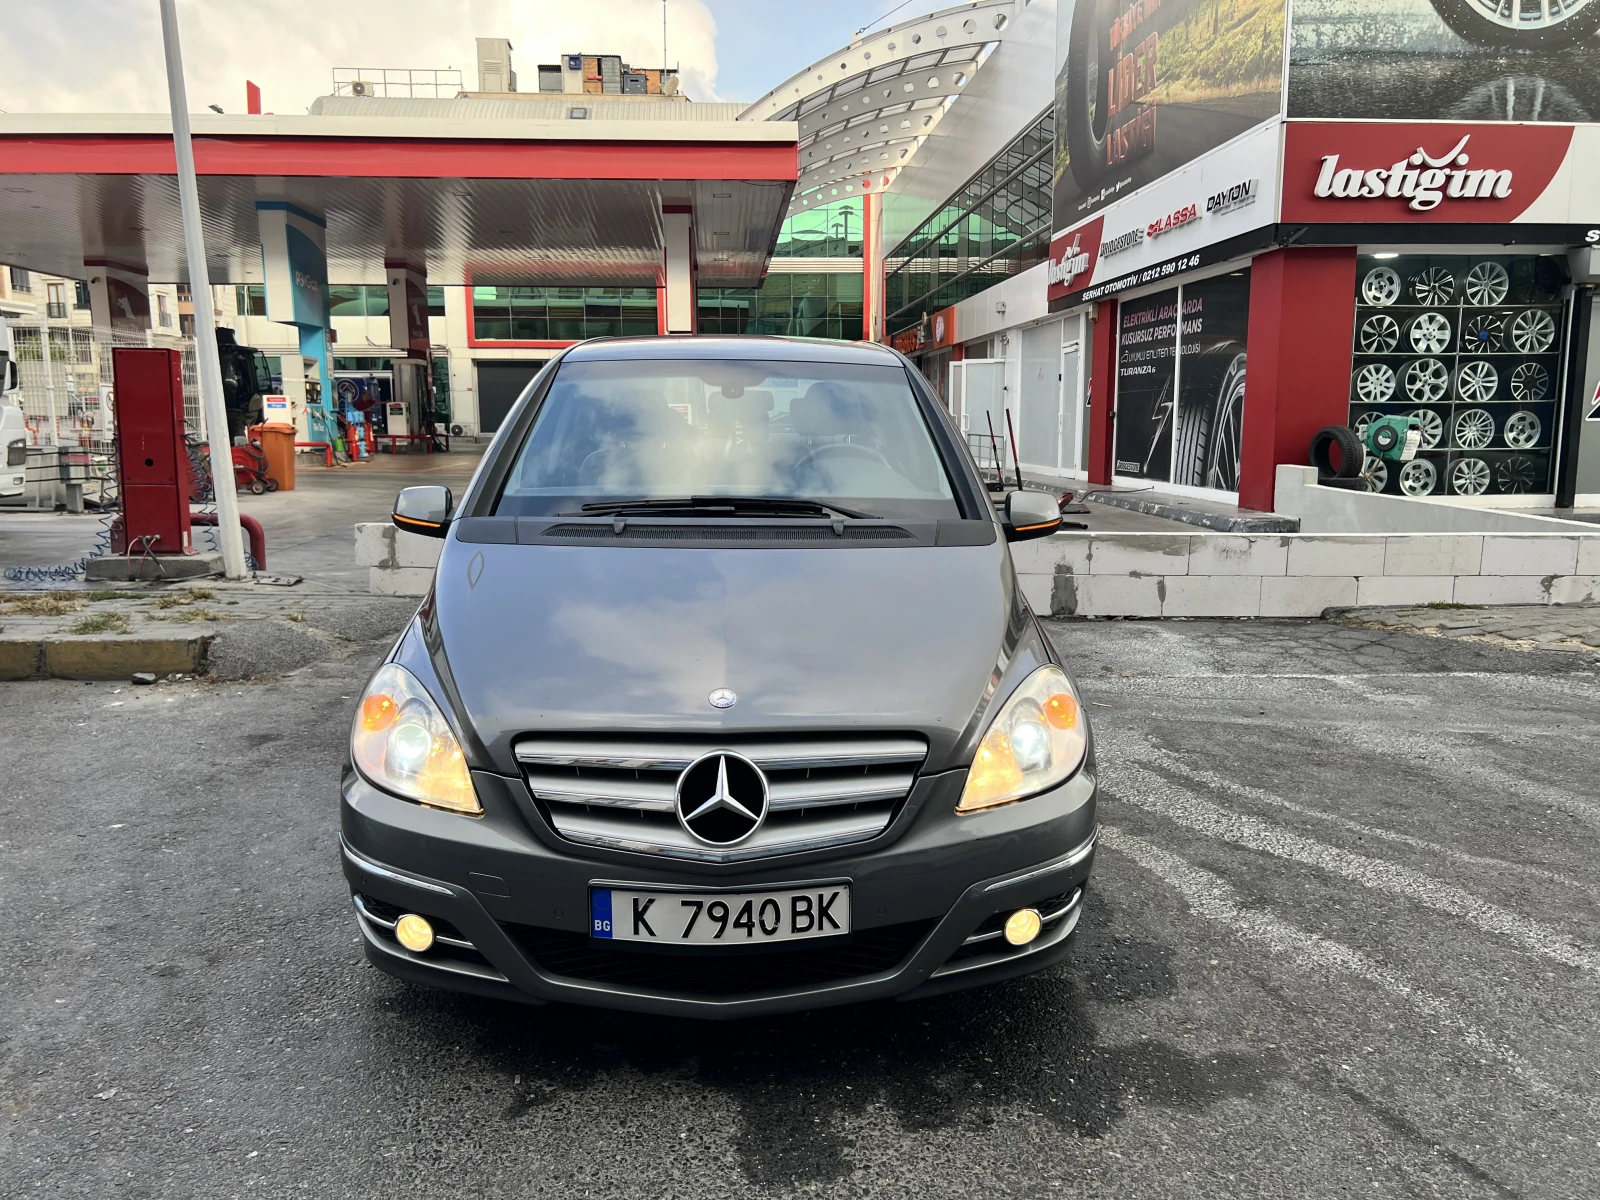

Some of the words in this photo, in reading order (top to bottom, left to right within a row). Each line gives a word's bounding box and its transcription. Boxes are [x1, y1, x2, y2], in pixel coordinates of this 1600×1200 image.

[1108, 31, 1158, 119] LİDER
[1106, 96, 1157, 168] LASTİĞİ
[1313, 134, 1513, 211] lastiğim
[1206, 180, 1252, 212] DAYTON
[1157, 203, 1197, 233] LASSA
[1100, 229, 1140, 257] BRIDGESTONE
[1082, 286, 1104, 301] SERHAT
[1104, 273, 1139, 295] OTOMOTİV
[1142, 268, 1160, 283] 0212
[1160, 262, 1176, 276] 590
[1177, 259, 1188, 271] 12
[1188, 254, 1200, 267] 46
[1123, 305, 1159, 328] ELEKTRİKLİ
[1158, 298, 1203, 320] ARAÇARDA
[1121, 328, 1154, 346] KUSURSUZ
[1153, 318, 1203, 340] PERFOMANS
[1169, 341, 1201, 357] TEOLOJİSİ
[1120, 365, 1152, 376] TURANZA
[594, 919, 611, 932] BG
[632, 897, 657, 937] K
[680, 898, 781, 939] 7940
[790, 891, 841, 934] BK
